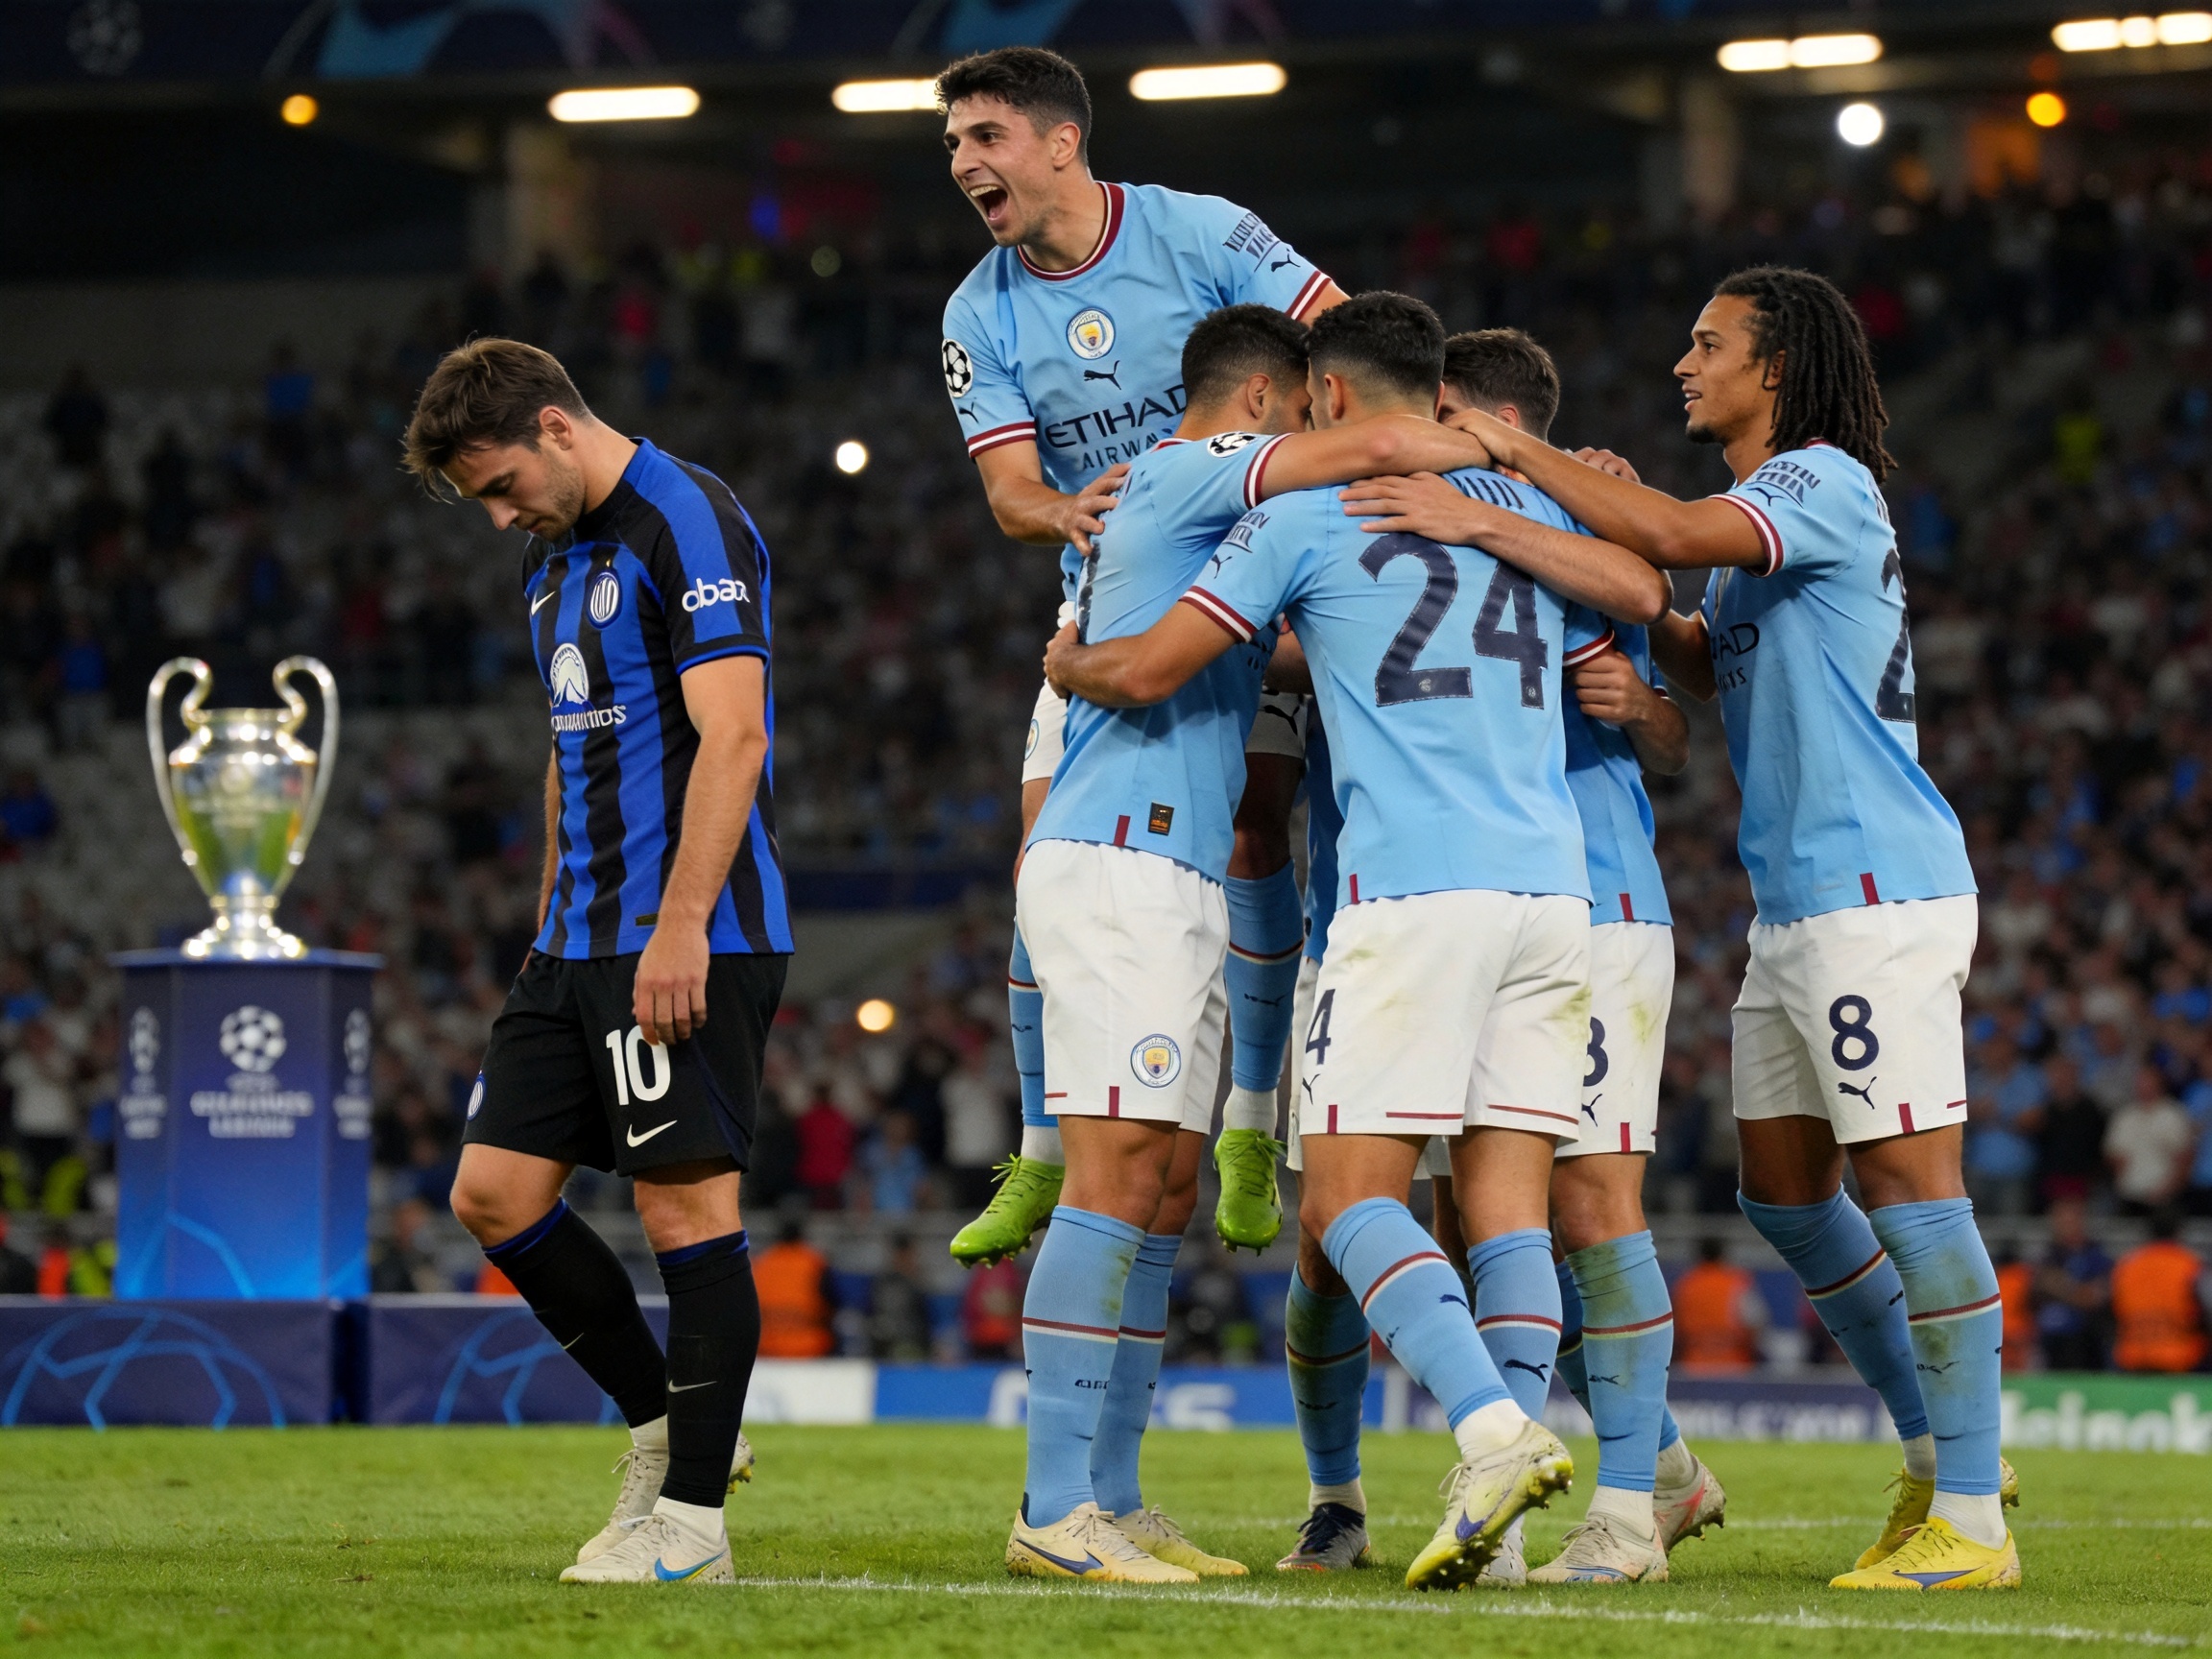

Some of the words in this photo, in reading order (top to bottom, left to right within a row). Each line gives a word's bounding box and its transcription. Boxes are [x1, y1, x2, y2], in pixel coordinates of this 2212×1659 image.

[1358, 532, 1549, 710] 24
[606, 1024, 671, 1106] 10
[1305, 988, 1335, 1066] 4
[1828, 994, 1880, 1071] 8
